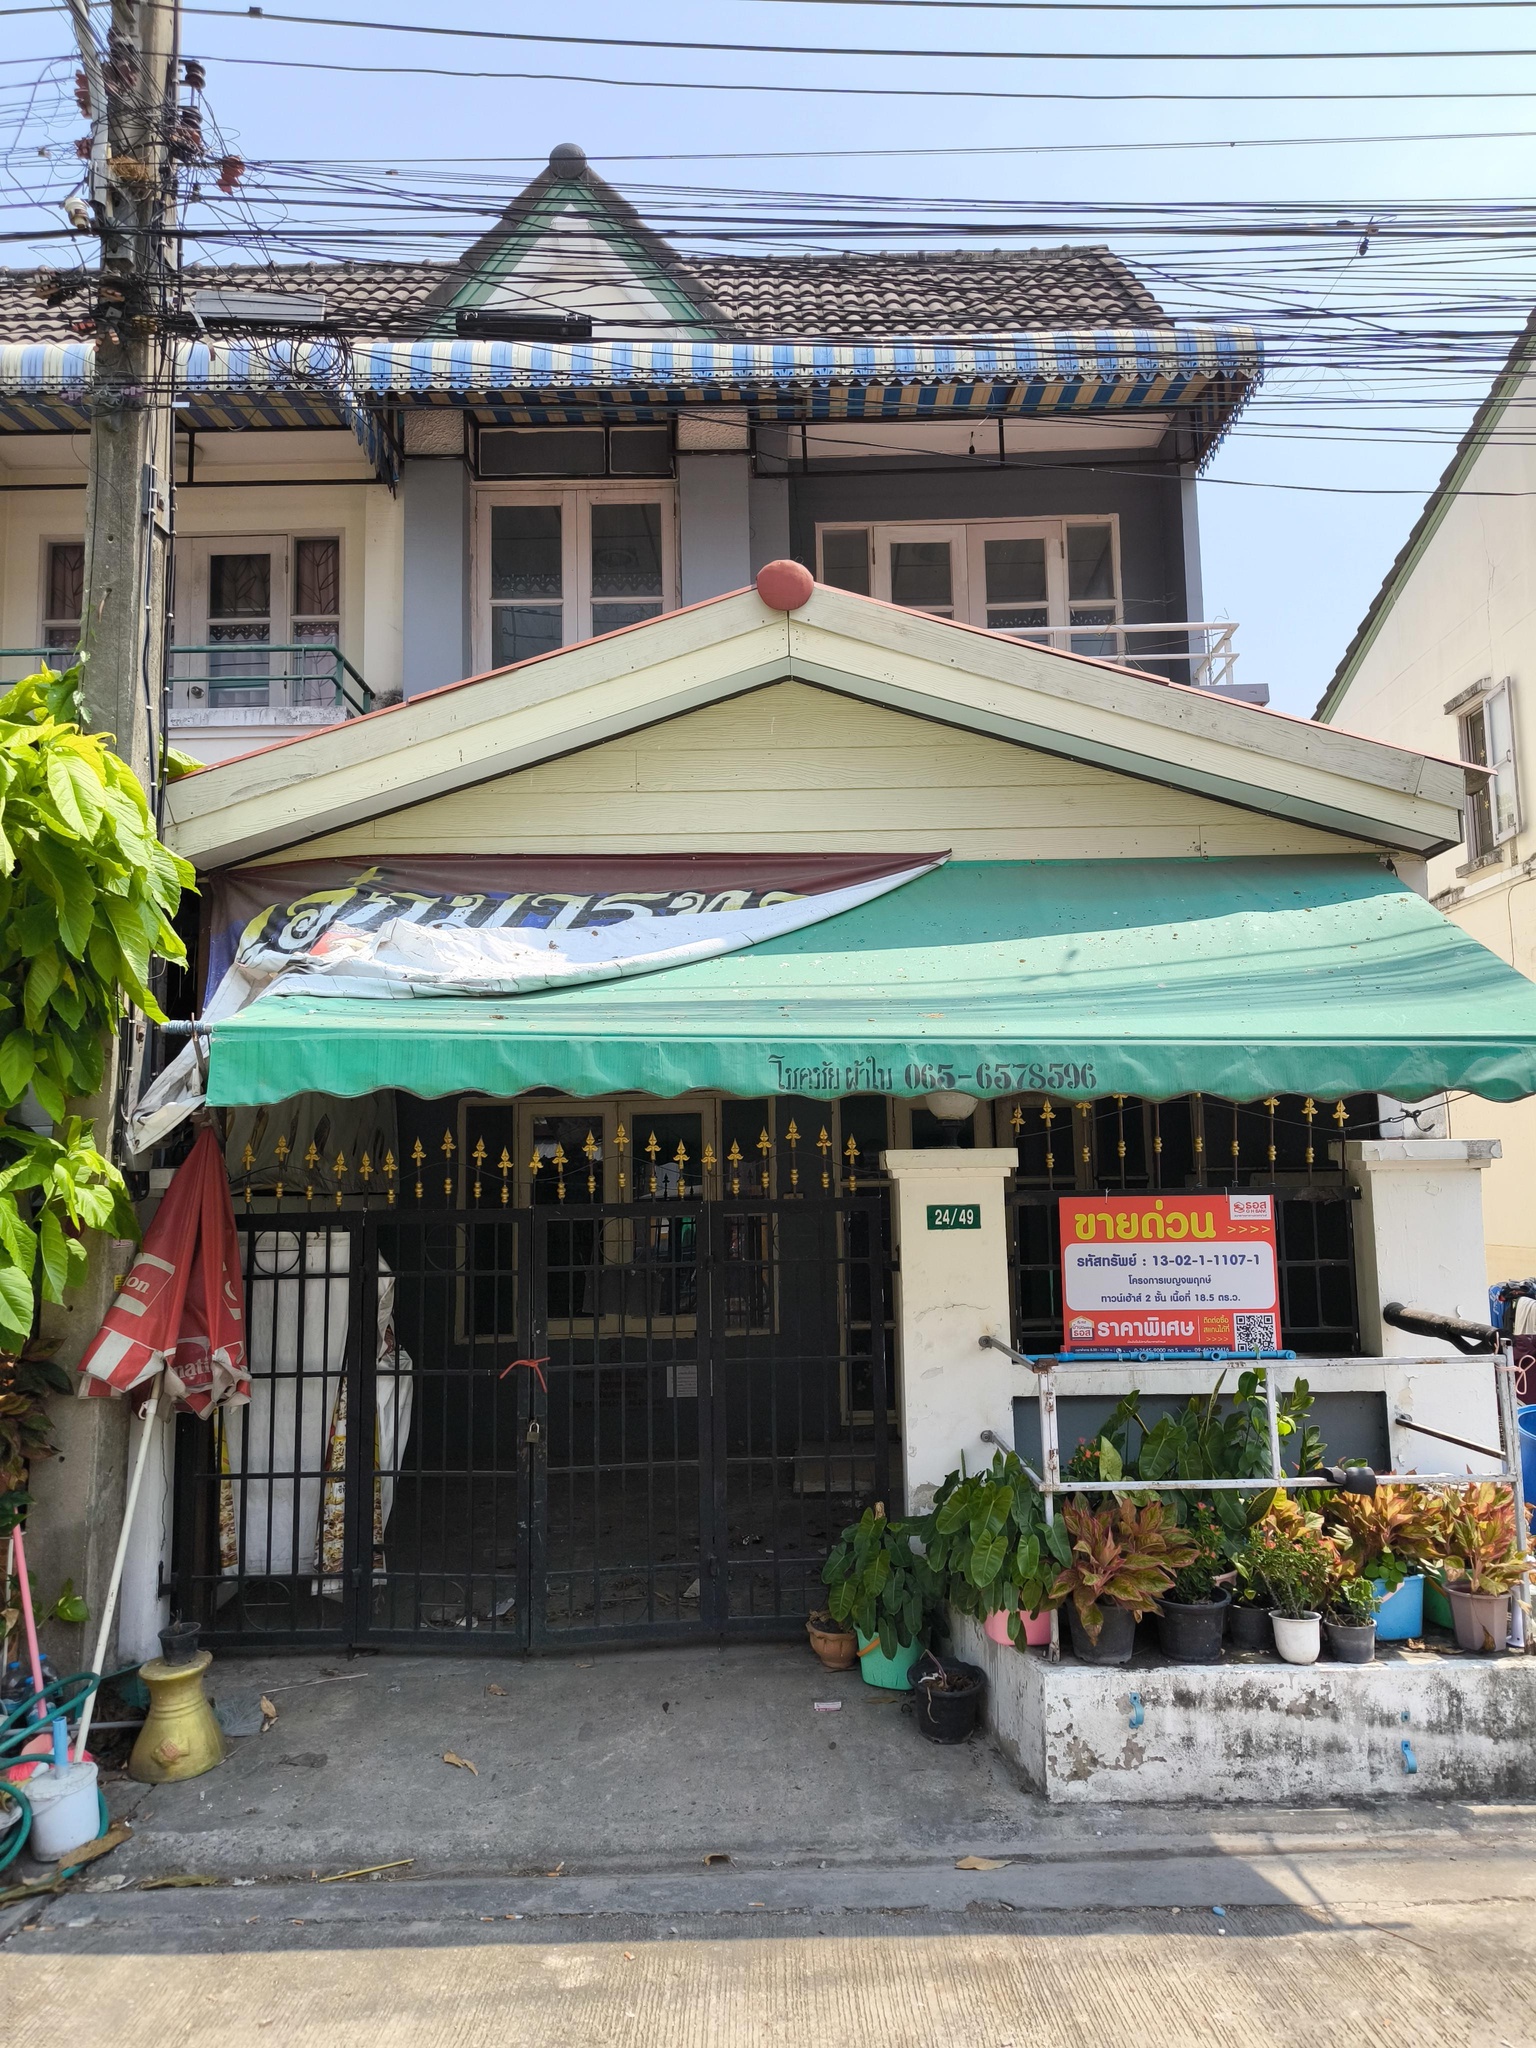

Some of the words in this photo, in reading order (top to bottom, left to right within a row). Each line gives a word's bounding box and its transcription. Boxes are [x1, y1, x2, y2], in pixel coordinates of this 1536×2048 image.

[845, 1055, 893, 1090] ผ้าใบ
[904, 1062, 1097, 1090] 065-6578596
[1245, 1201, 1267, 1210] ธอส
[934, 1208, 974, 1226] 24/49
[1074, 1199, 1217, 1240] ขายด่วน
[1077, 1253, 1137, 1267] รหัสทรัพย์
[1152, 1254, 1260, 1266] 13-02-1-1107-1
[1128, 1274, 1212, 1287] โครงการเบญจพฤกษ์
[1101, 1293, 1142, 1303] ทาวน์เฮ้าส์
[1145, 1294, 1151, 1302] 2
[1154, 1290, 1167, 1302] ชั้น
[1170, 1290, 1191, 1302] เนื้อที่
[1194, 1293, 1215, 1302] 18.5
[1217, 1294, 1241, 1302] ตร.ว.
[1097, 1316, 1195, 1337] ราคาพิเศษ
